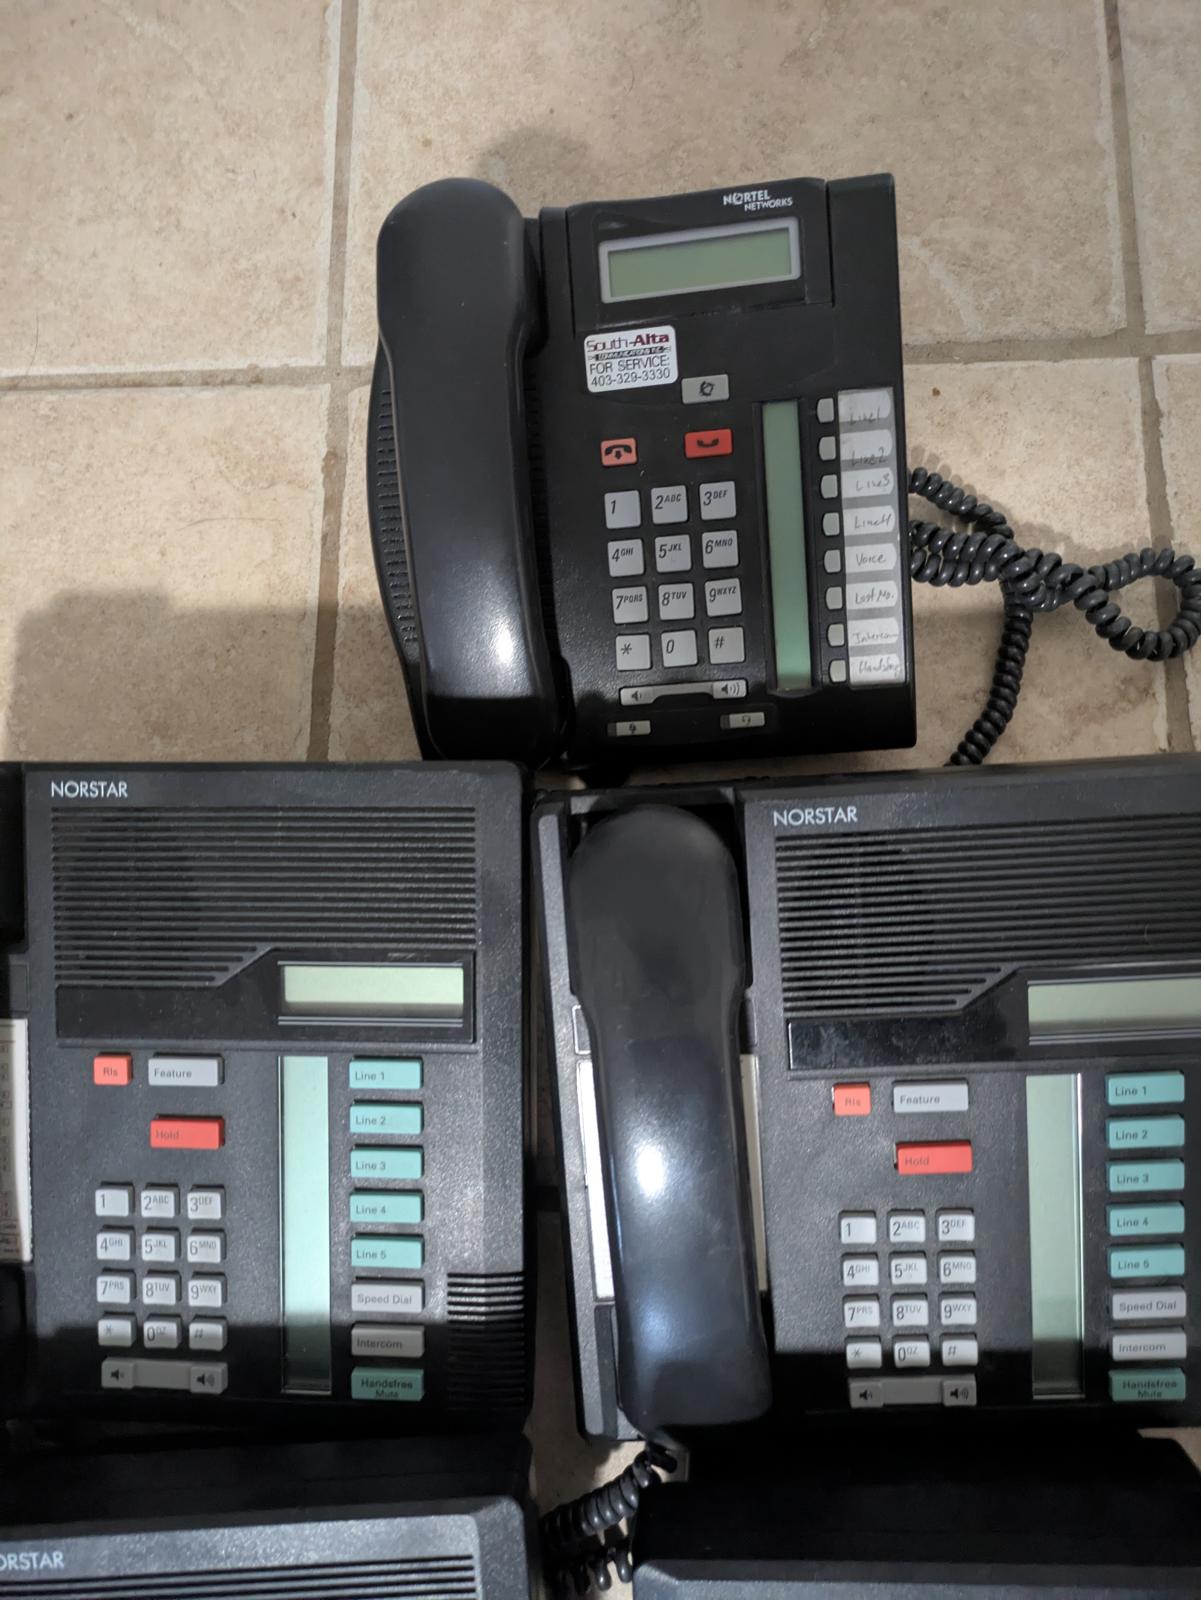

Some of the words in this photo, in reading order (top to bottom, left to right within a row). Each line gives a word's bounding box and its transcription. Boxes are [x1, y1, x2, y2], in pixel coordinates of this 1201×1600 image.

[723, 189, 770, 206] NORTEL
[744, 197, 793, 212] NETWORKS
[586, 333, 669, 352] South-Alta
[589, 361, 613, 375] FOR
[618, 355, 670, 372] SERVICE:
[591, 367, 670, 387] 403-329-3330
[610, 500, 616, 515] 1
[51, 780, 128, 798] NORSTAR
[773, 805, 858, 827] NORSTAR
[154, 1068, 193, 1078] Feature
[355, 1071, 376, 1081] Line
[381, 1071, 385, 1081] 1
[1115, 1087, 1138, 1097] Line
[1142, 1086, 1147, 1096] 1
[900, 1095, 941, 1105] Feature
[355, 1115, 377, 1126] Line
[380, 1116, 386, 1126] 2
[155, 1130, 180, 1140] Hold
[1115, 1130, 1139, 1141] Line
[1142, 1129, 1148, 1140] 2
[355, 1160, 377, 1170] Line
[380, 1161, 387, 1171] 3
[905, 1156, 930, 1166] Hold
[1116, 1174, 1140, 1185] Line
[1142, 1173, 1149, 1184] 3
[100, 1193, 106, 1209] 1
[355, 1204, 377, 1215] Line
[380, 1205, 387, 1215] 4
[1116, 1217, 1139, 1228] Line
[1142, 1217, 1149, 1227] 4
[846, 1222, 851, 1237] 1
[356, 1250, 378, 1260] Line
[380, 1250, 387, 1260] 5
[1118, 1260, 1140, 1271] Line
[357, 1293, 390, 1305] Speed
[392, 1295, 412, 1305] Dial
[1119, 1302, 1153, 1313] Speed
[1156, 1301, 1177, 1310] Dial
[357, 1337, 403, 1349] Intercom
[1119, 1343, 1167, 1353] Intercom
